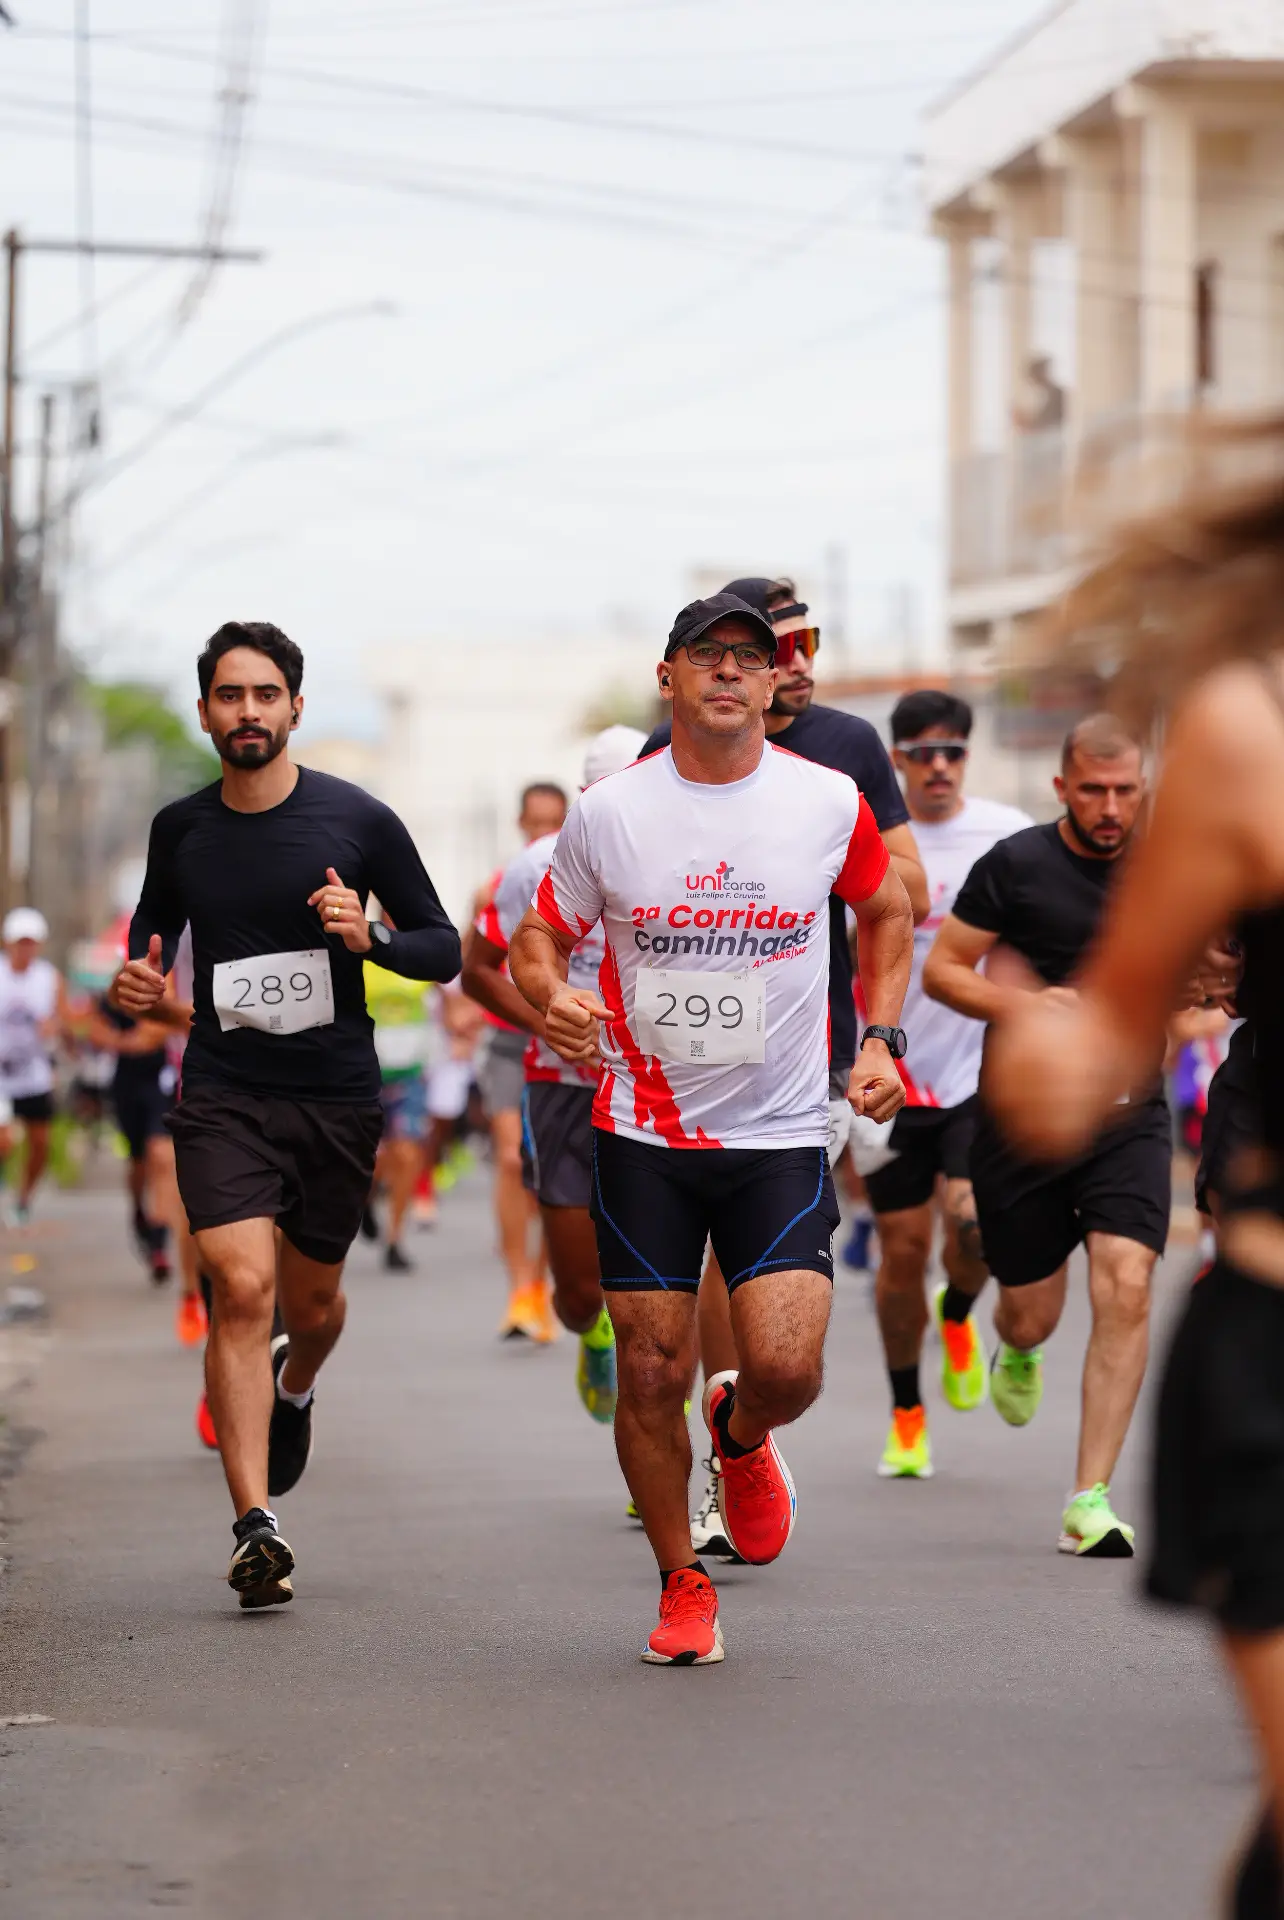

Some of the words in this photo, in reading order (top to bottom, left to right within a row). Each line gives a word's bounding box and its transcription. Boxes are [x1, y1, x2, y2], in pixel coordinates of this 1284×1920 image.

[702, 892, 724, 900] Felipe
[668, 902, 799, 930] Corrida
[232, 972, 313, 1009] 289
[654, 992, 744, 1029] 299
